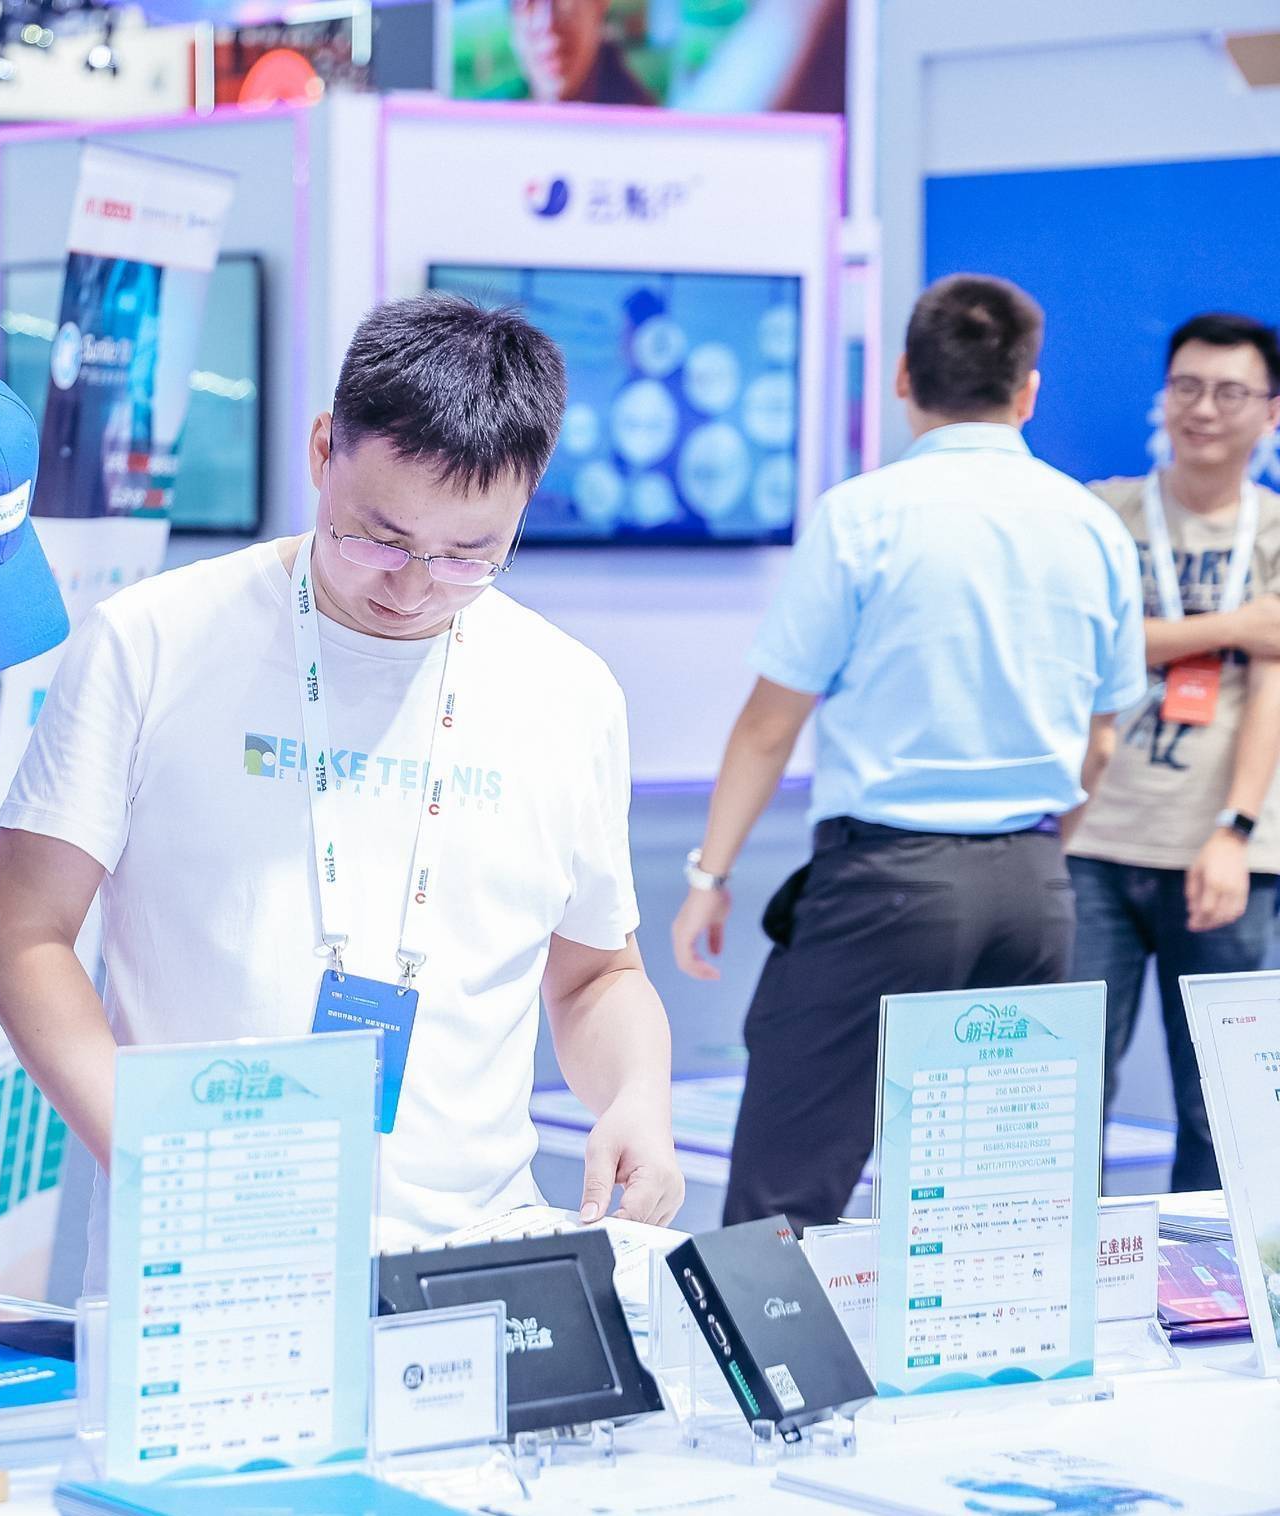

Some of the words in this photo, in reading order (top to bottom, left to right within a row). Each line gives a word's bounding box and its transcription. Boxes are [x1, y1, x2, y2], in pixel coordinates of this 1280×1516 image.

[302, 588, 310, 614] TEDA
[1001, 1004, 1018, 1017] 4G
[966, 1018, 1030, 1042] 筋斗云盒
[979, 1047, 1014, 1060] 技术参数
[1004, 1067, 1018, 1076] ARM
